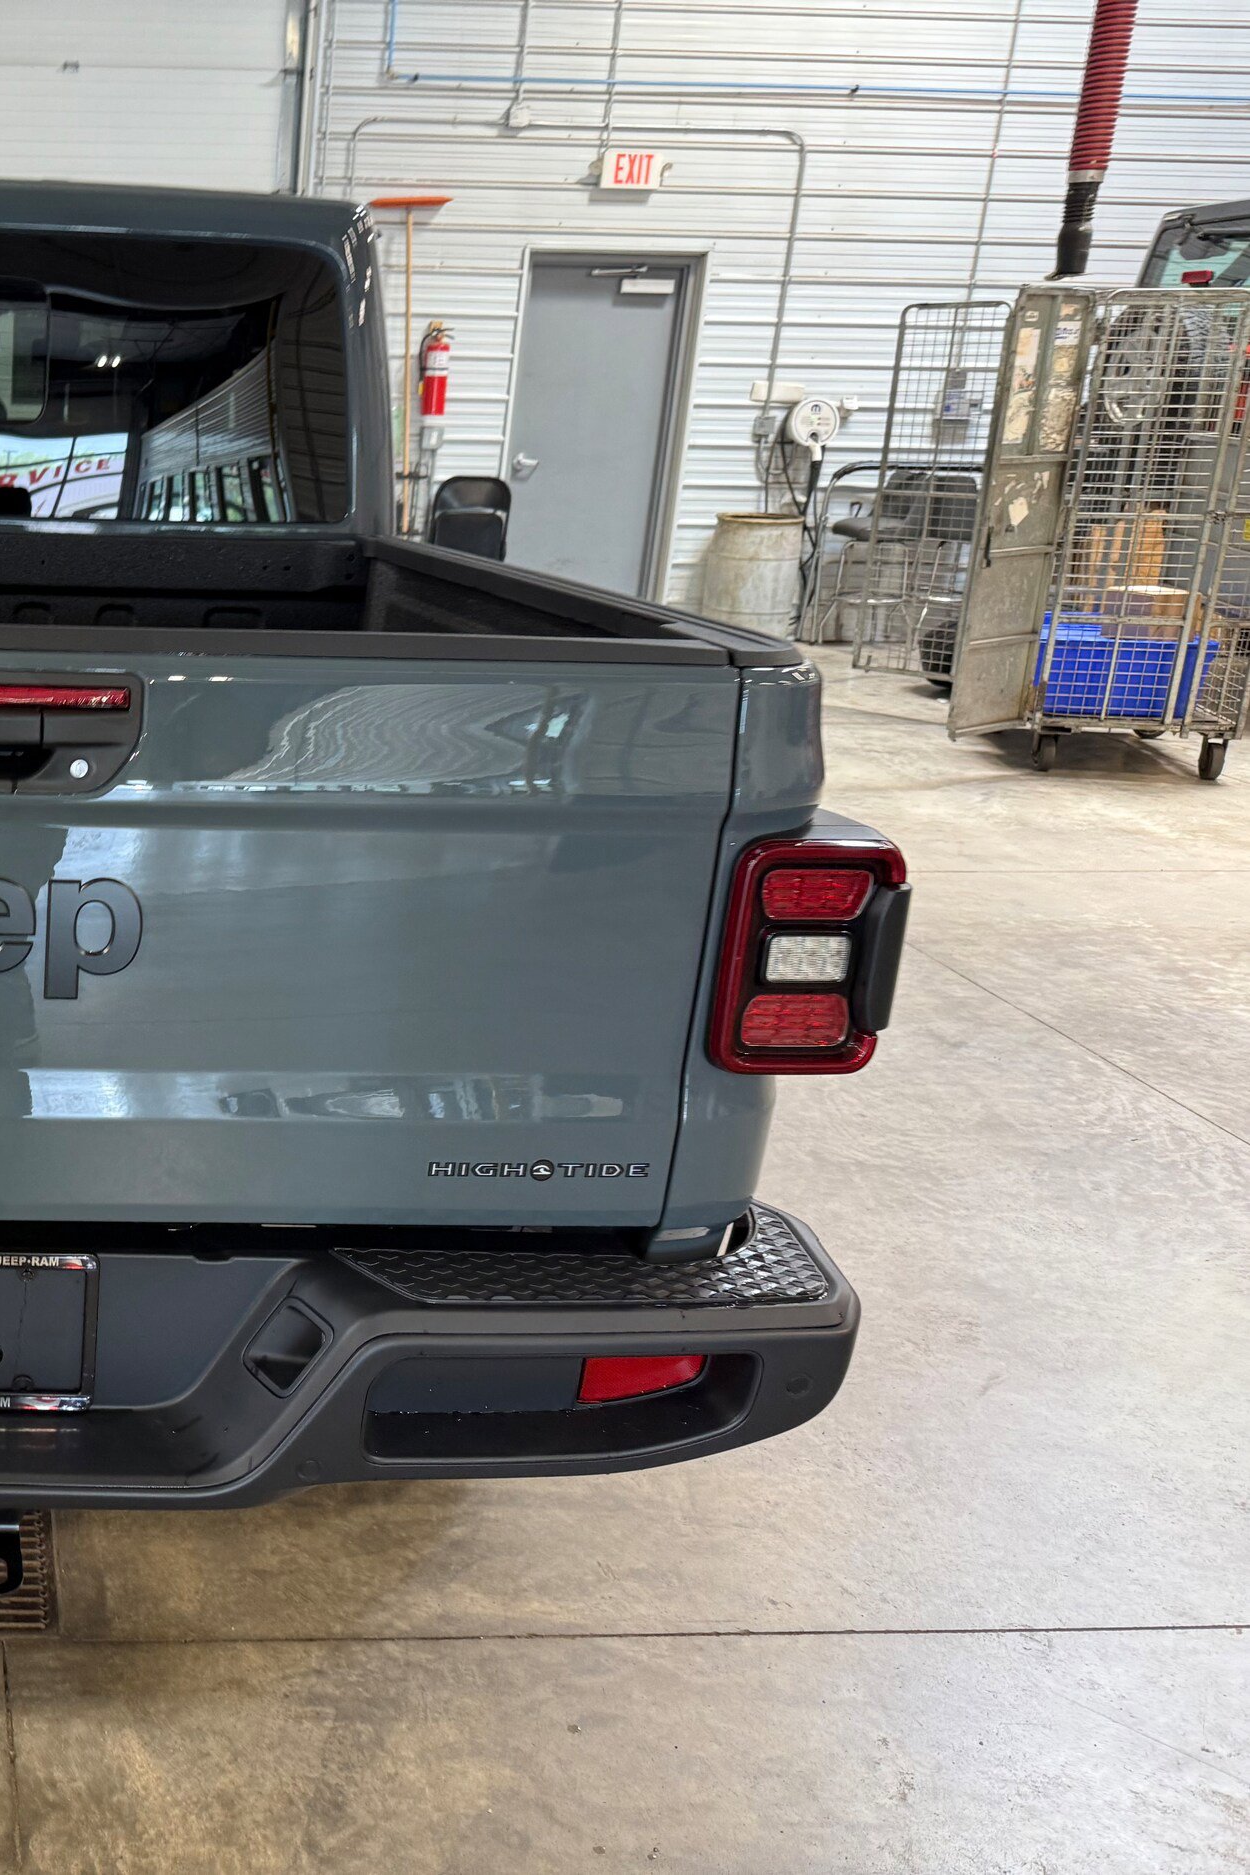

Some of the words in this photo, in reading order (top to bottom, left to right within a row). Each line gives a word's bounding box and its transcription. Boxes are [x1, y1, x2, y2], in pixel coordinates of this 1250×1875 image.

[613, 153, 655, 185] EXIT
[427, 1161, 528, 1177] HIGH
[557, 1162, 651, 1178] TIDE
